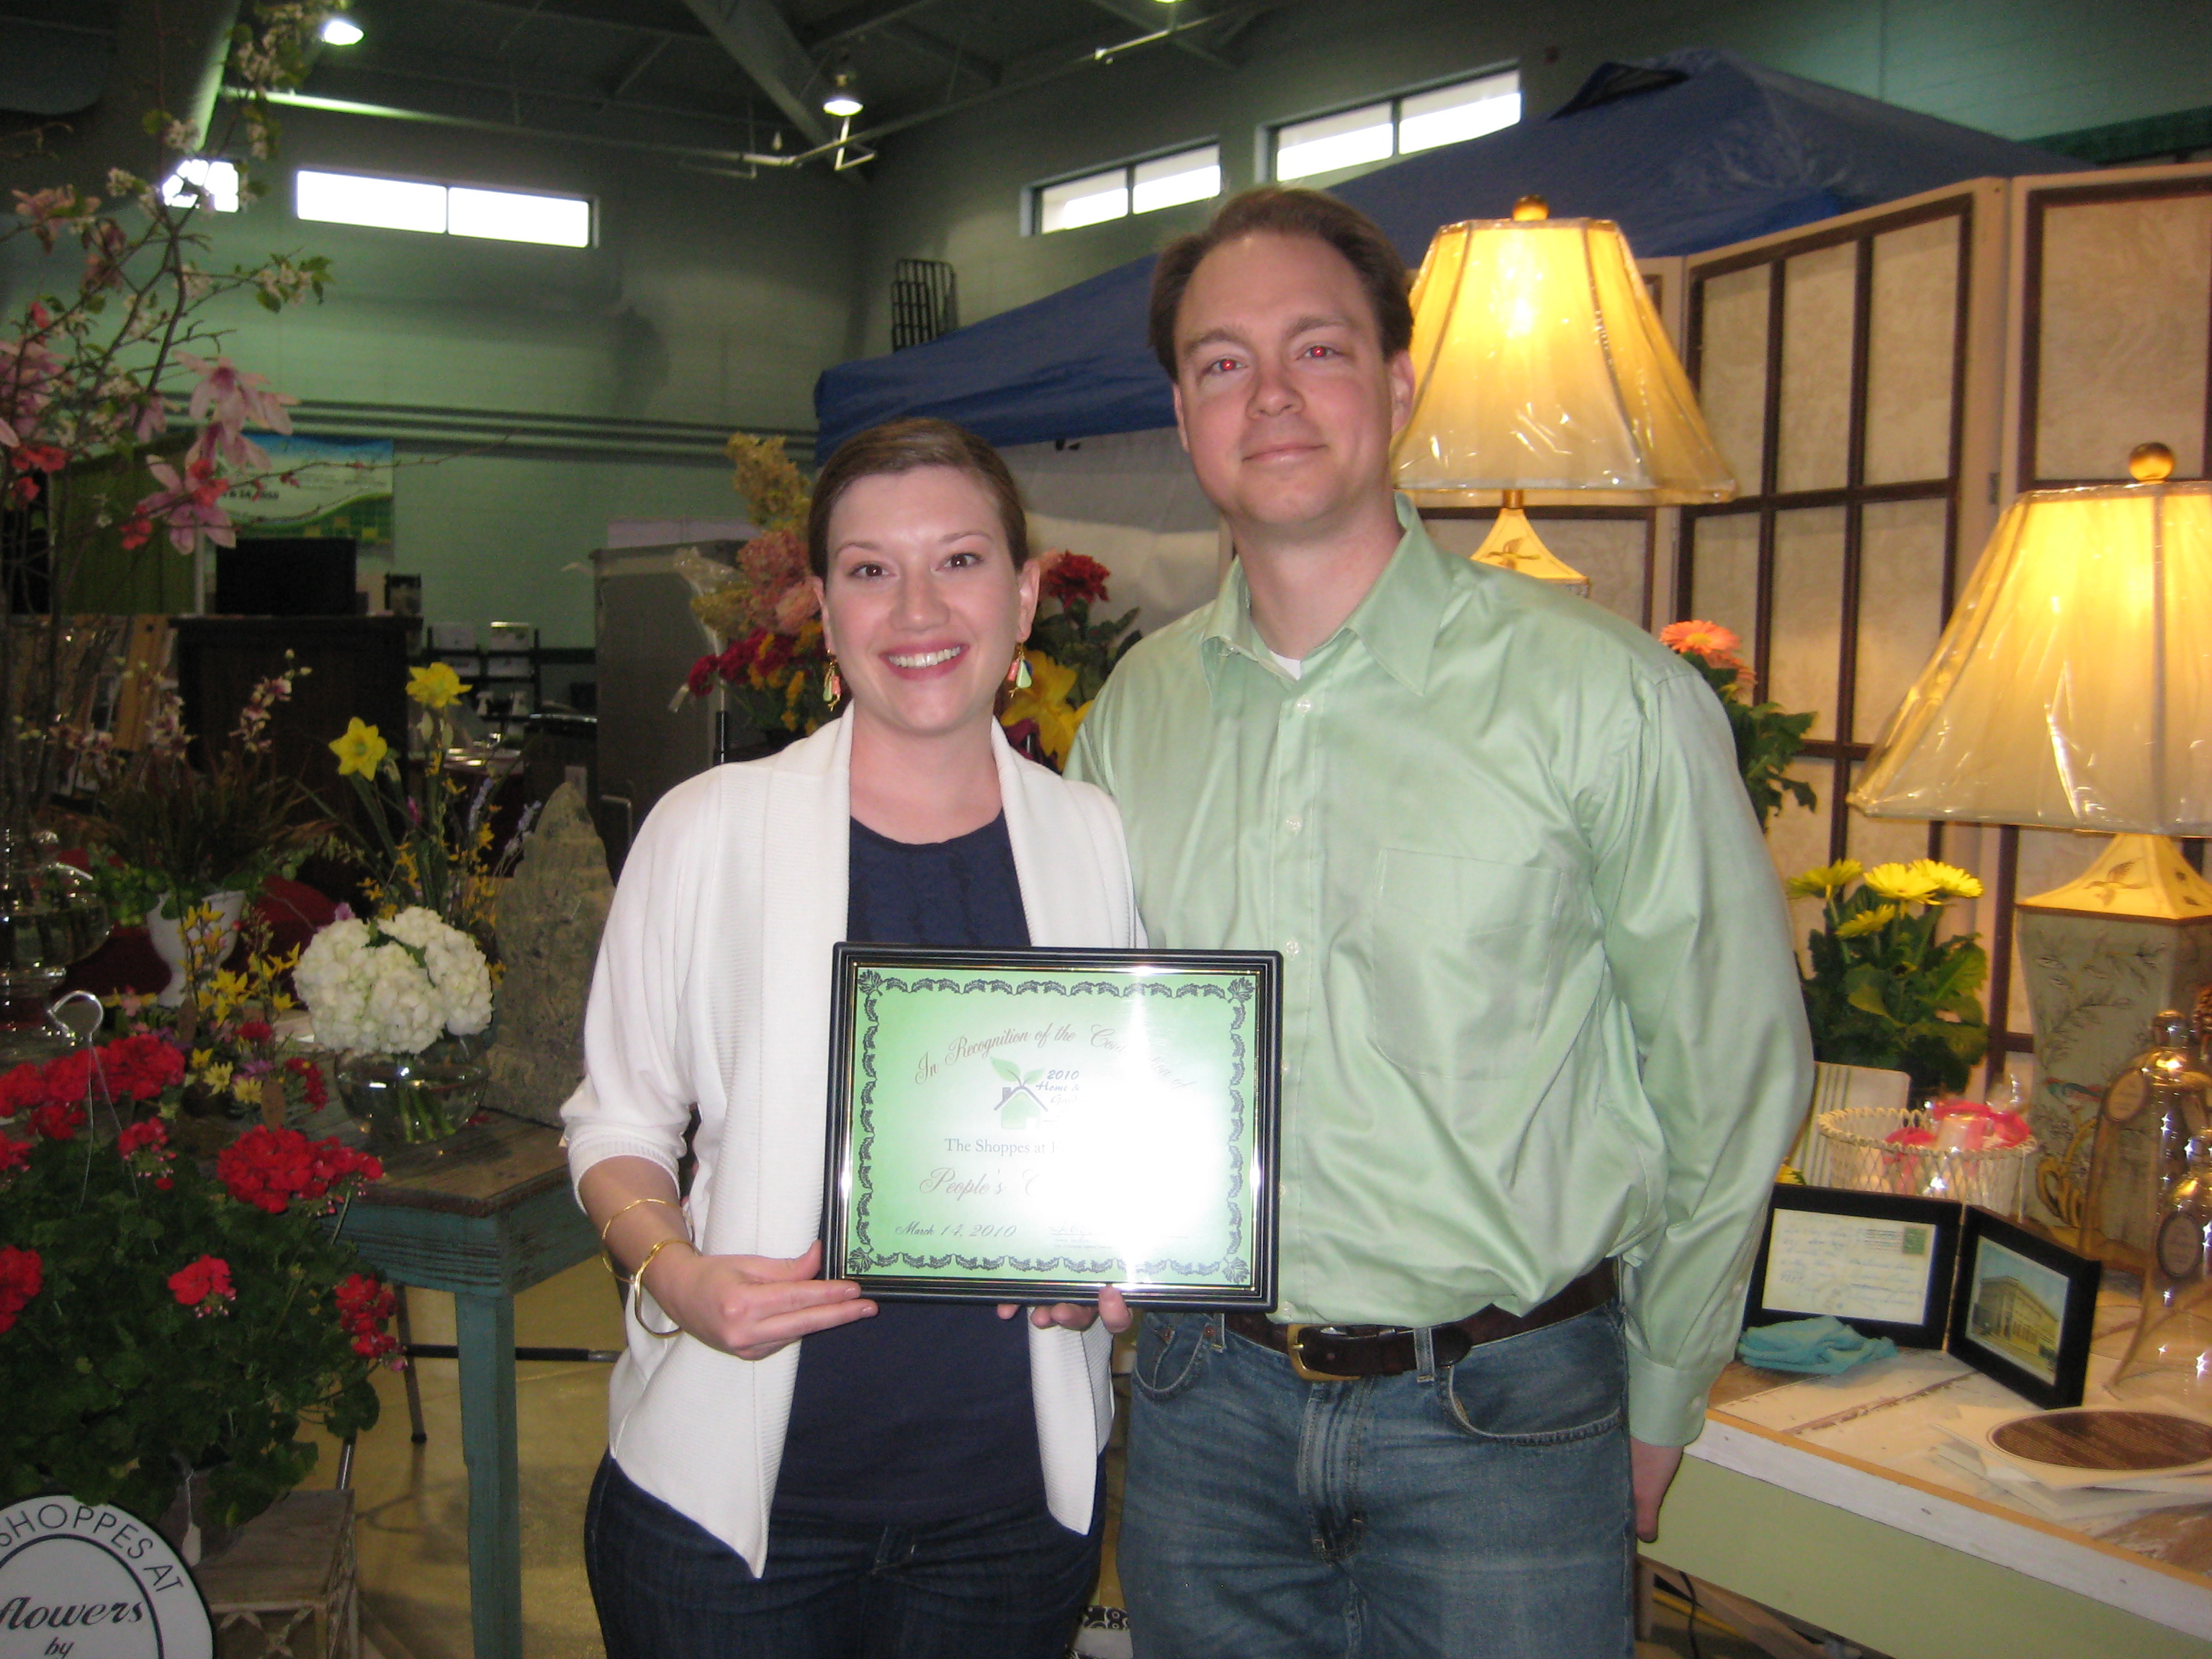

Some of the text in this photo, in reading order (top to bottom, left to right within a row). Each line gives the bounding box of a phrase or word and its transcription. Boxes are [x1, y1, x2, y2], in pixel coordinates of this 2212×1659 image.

[914, 1051, 938, 1084] In
[945, 1028, 1031, 1066] Recognition
[1034, 1022, 1053, 1048] of
[1053, 1023, 1076, 1042] the
[1046, 1069, 1080, 1081] 2010
[1035, 1080, 1081, 1092] Home &
[944, 1138, 971, 1152] The
[975, 1138, 1030, 1156] Shoppes
[1034, 1143, 1046, 1154] at
[919, 1166, 1006, 1201] People's
[895, 1220, 935, 1236] March
[968, 1224, 1017, 1238] 2010
[143, 1564, 184, 1592] AT
[44, 1636, 75, 1659] by
